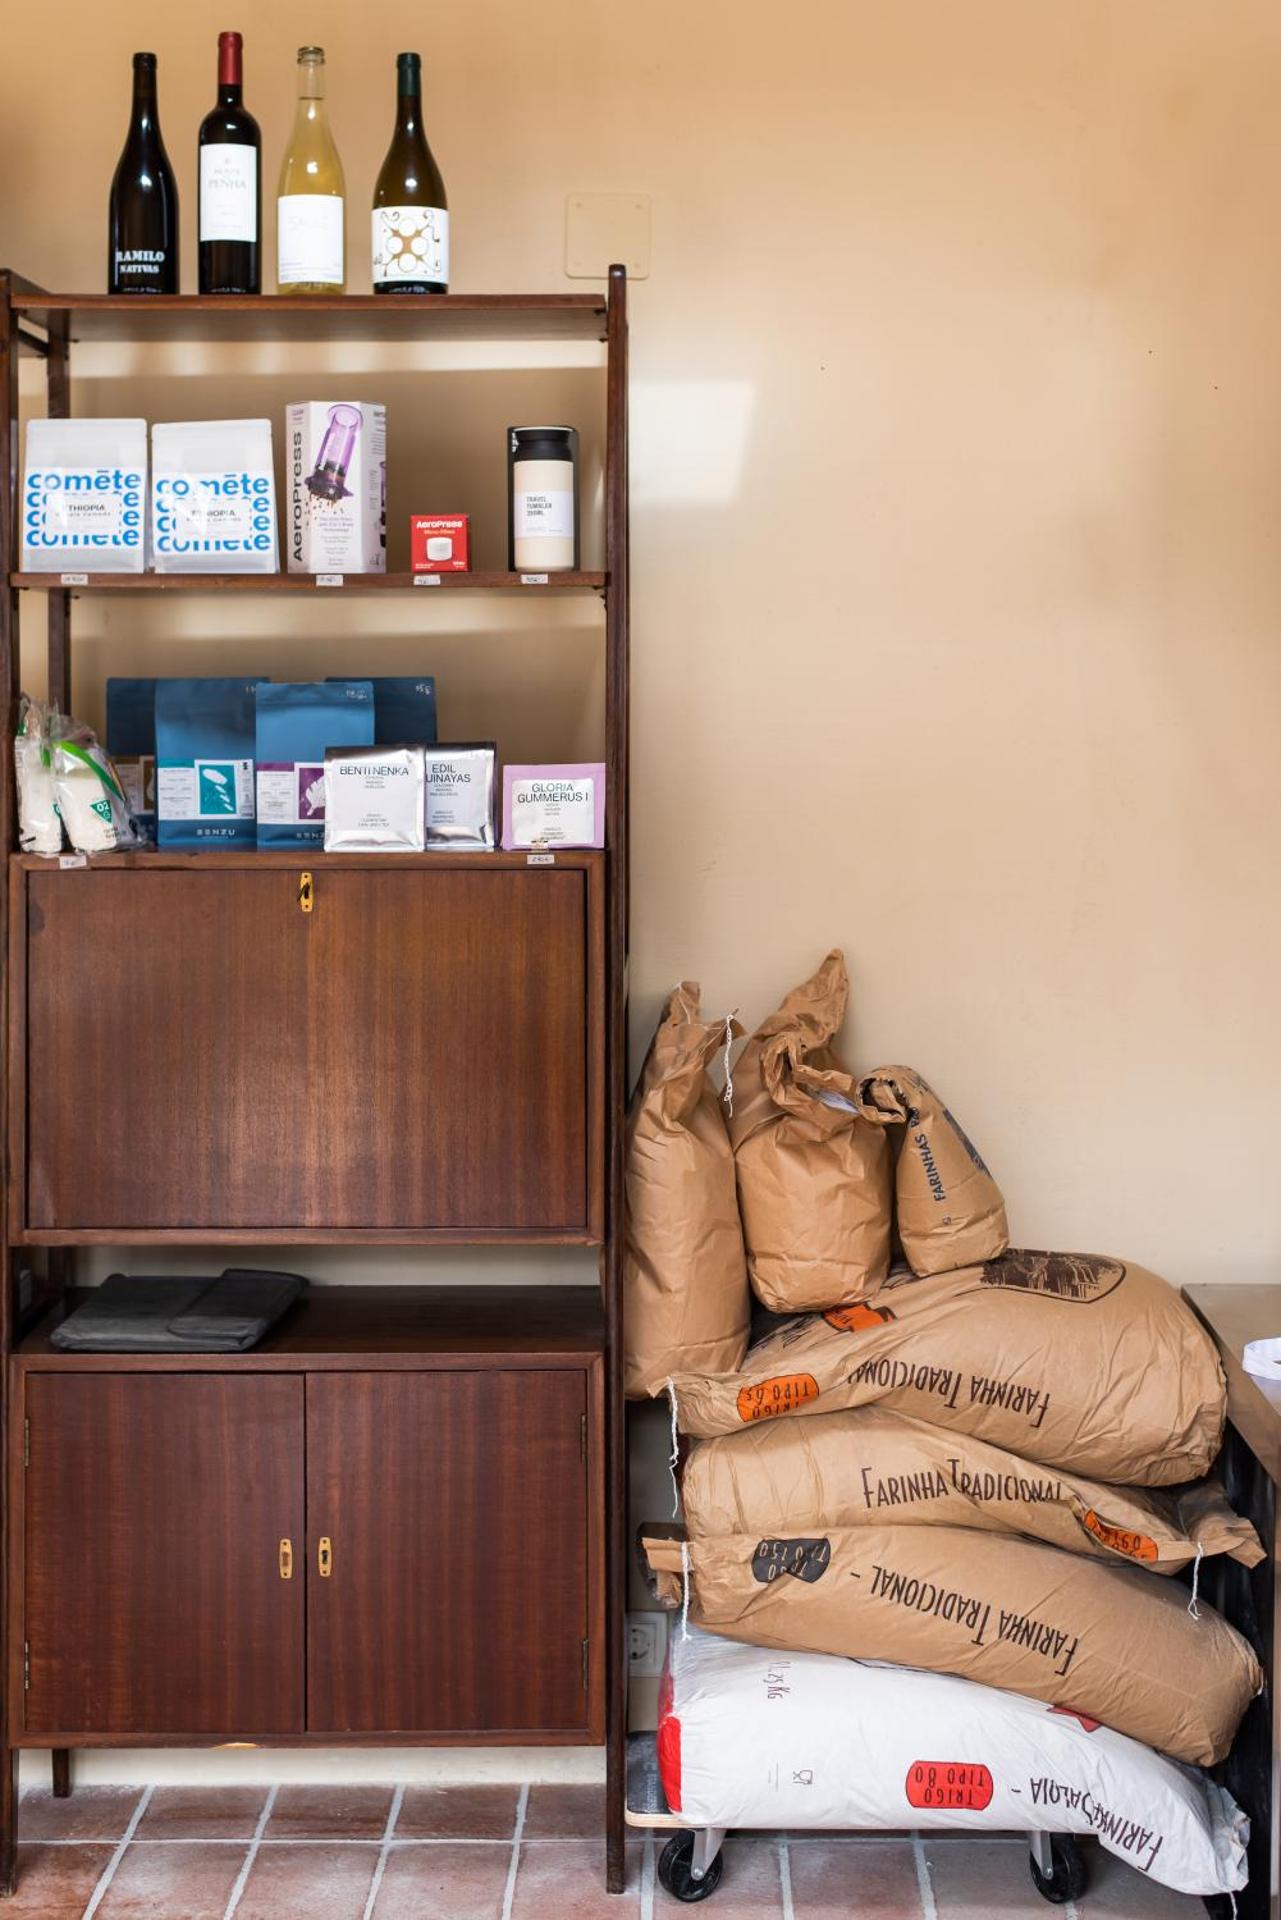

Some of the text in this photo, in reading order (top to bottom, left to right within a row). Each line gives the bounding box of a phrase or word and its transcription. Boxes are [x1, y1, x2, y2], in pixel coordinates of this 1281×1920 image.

[116, 250, 166, 263] RAMILO
[293, 431, 304, 562] AeroPress
[416, 520, 463, 529] AeroPress
[339, 766, 409, 776] BENTI NENKA
[432, 763, 456, 774] EDIL
[531, 783, 574, 792] GLORIA
[517, 792, 583, 804] GUMMERUS
[914, 1133, 946, 1201] FARINHAS
[773, 1381, 809, 1400] TIPO
[970, 1375, 1051, 1428] FARINHA
[861, 1467, 949, 1508] FARINHA
[871, 1565, 992, 1646] TRADICIONAL
[998, 1609, 1079, 1677] FARINHA
[915, 1766, 985, 1788] TIPO 80
[924, 1787, 974, 1806] TRIGO
